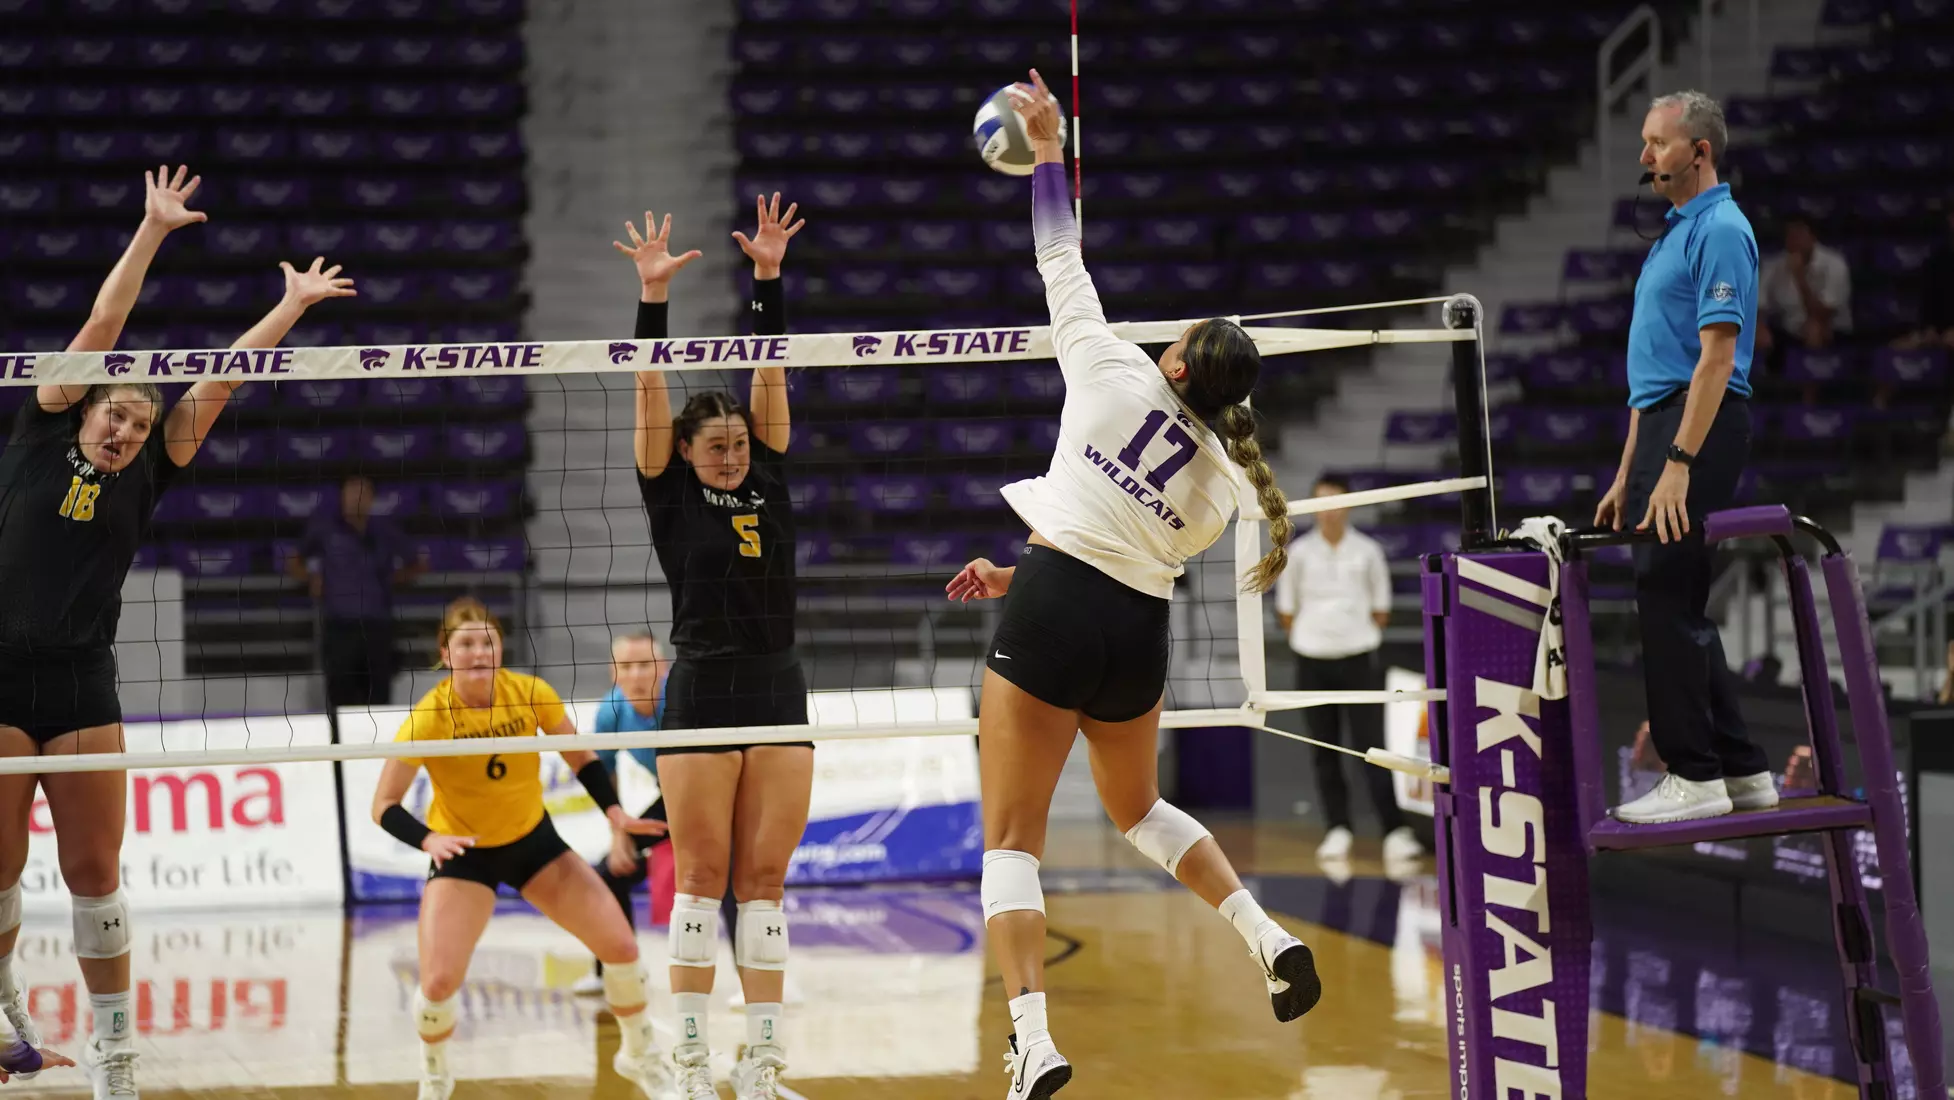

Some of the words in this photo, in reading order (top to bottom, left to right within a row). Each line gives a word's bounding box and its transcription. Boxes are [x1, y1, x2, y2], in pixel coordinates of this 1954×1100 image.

[147, 350, 294, 377] K-STATE
[401, 344, 544, 371] K-STATE
[649, 337, 790, 365] K-STATE
[892, 329, 1031, 357] K-STATE
[1117, 409, 1199, 493] 17
[58, 475, 101, 522] 18
[1083, 443, 1186, 531] WILDCATS
[731, 513, 762, 558] 5
[486, 753, 507, 780] 6
[1474, 675, 1563, 1100] K-STATE
[1453, 963, 1466, 1037] sports
